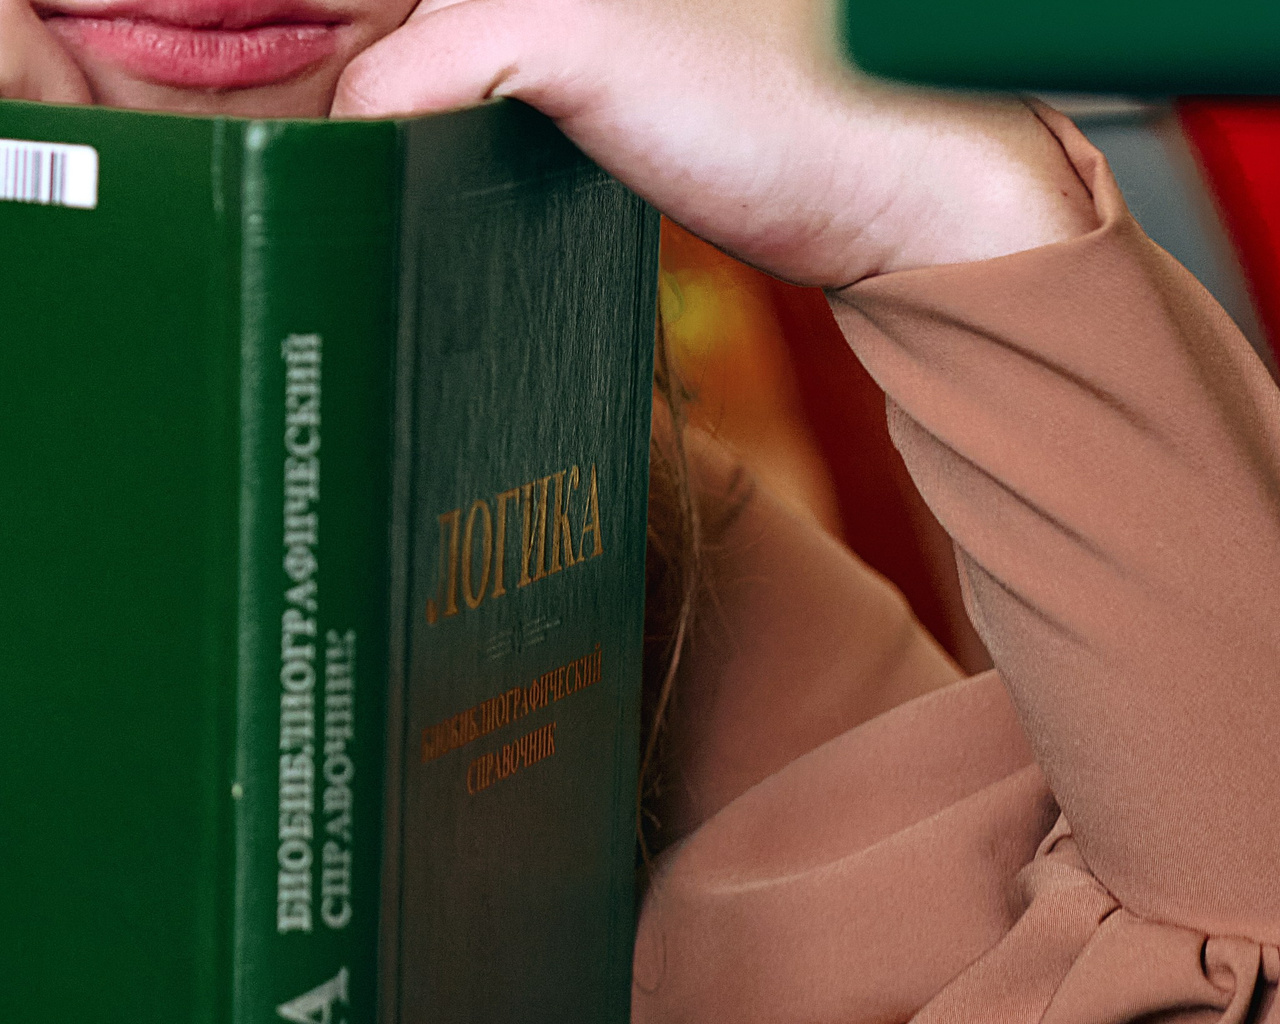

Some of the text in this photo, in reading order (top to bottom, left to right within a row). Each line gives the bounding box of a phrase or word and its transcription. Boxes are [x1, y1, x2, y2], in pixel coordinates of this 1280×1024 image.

[426, 462, 604, 624] ЛОГИКА
[279, 332, 322, 934] БИОБИБЛИОГРАФИЧЕСКИЙ
[420, 642, 602, 765] БИОБИБЛИОГРАФИЧЕСКИЙ
[321, 628, 356, 929] СПРАВОЧНИК
[466, 721, 556, 795] СПРАВОЧНИК
